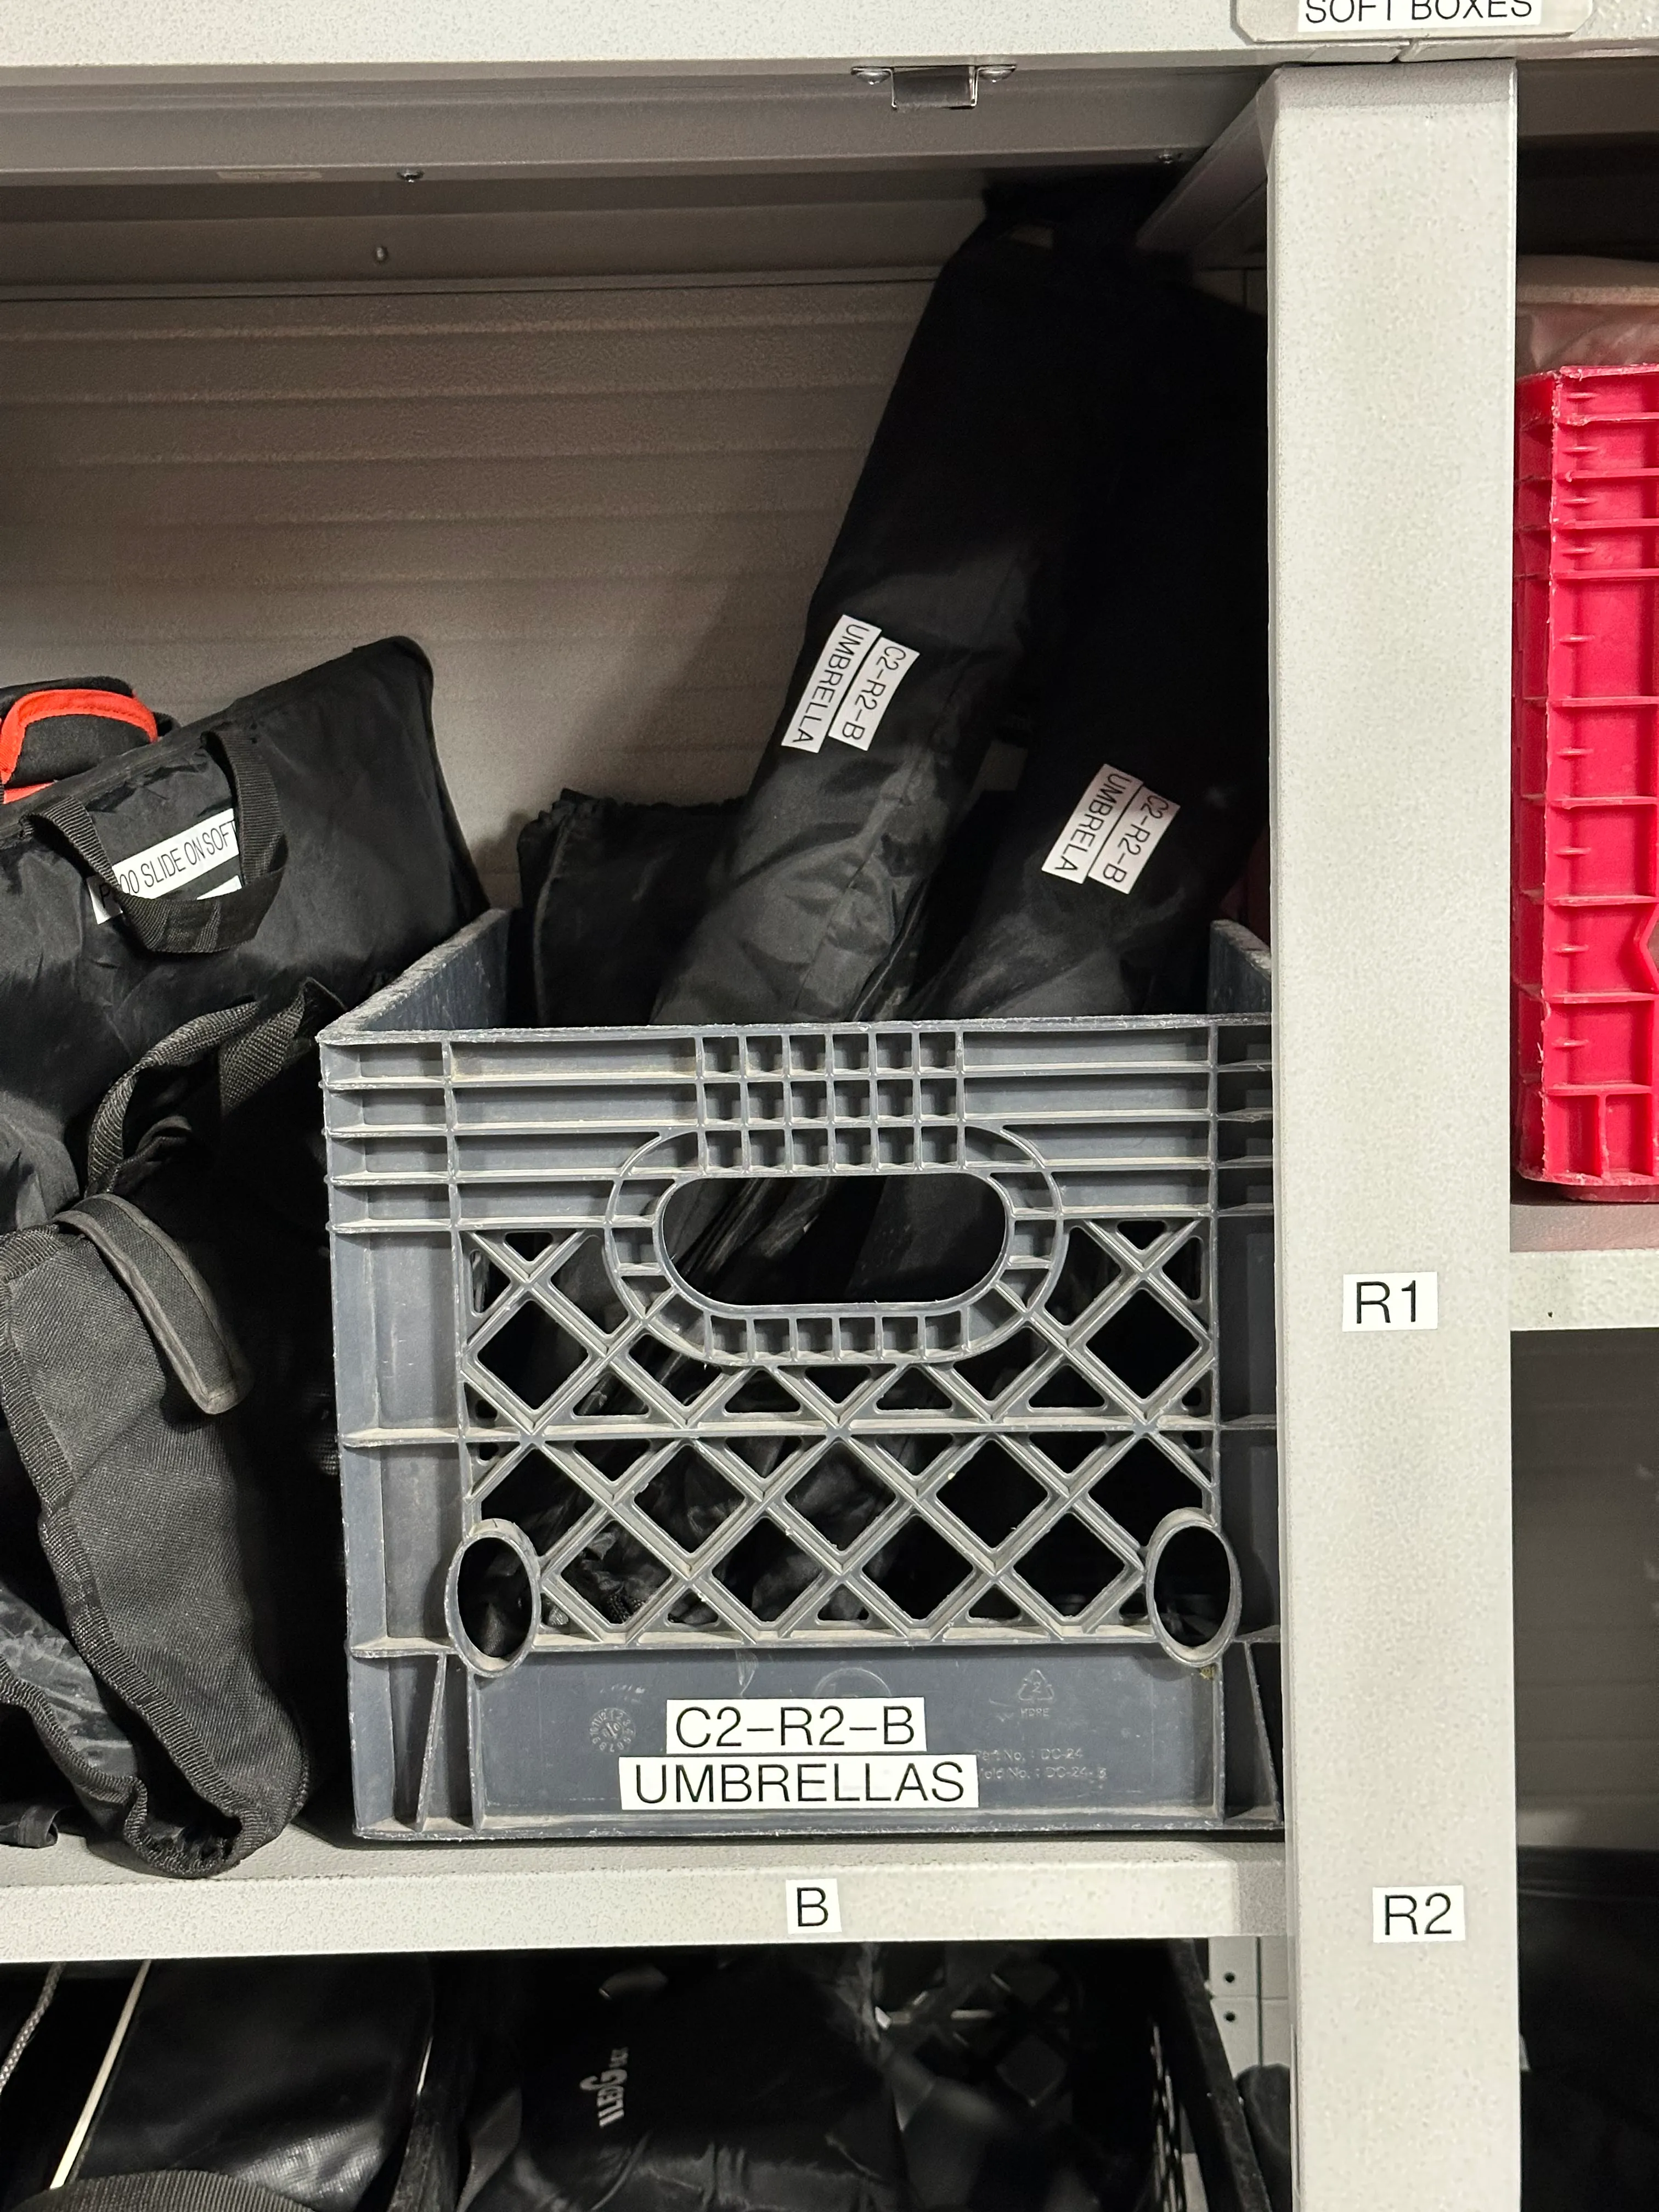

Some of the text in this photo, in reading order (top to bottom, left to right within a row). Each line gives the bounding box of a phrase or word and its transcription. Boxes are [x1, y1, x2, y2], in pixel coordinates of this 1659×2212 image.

[1412, 0, 1532, 20] BOXES
[792, 624, 870, 743] UMBRELLA
[842, 646, 906, 740] C2-R2-B
[1054, 773, 1132, 871] UMBRELA
[1103, 795, 1169, 883] C2-R2-B
[140, 848, 186, 887] SLIDE
[184, 837, 206, 865] ON
[1356, 1280, 1416, 1324] R1
[676, 1706, 915, 1748] C2-R2-B
[636, 1761, 964, 1804] UMBRELLAS
[797, 1887, 828, 1927] B
[1385, 1892, 1452, 1935] R2
